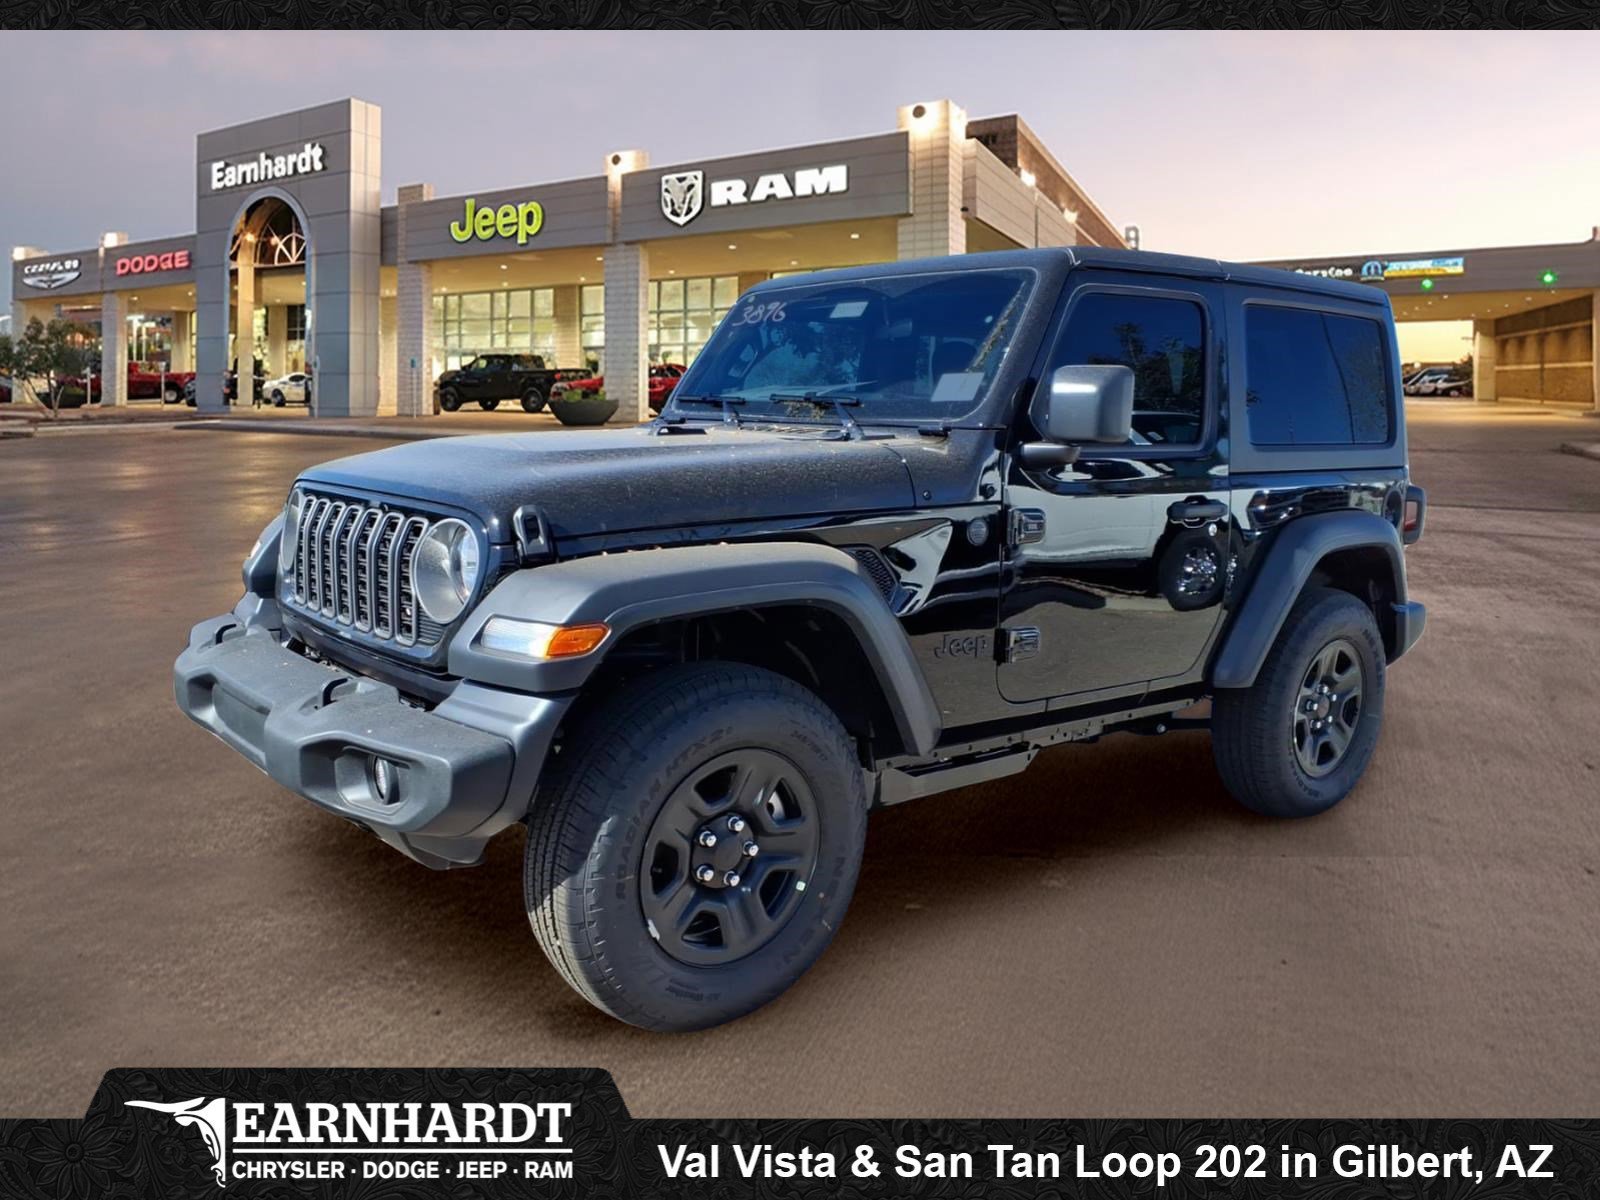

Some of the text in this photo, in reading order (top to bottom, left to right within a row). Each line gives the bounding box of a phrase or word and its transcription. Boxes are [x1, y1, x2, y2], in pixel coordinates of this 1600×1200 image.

[211, 143, 324, 190] Earnhardt
[711, 165, 848, 207] RAM
[449, 198, 544, 245] Jeep
[116, 250, 191, 276] DODGE
[934, 633, 987, 659] Jeep
